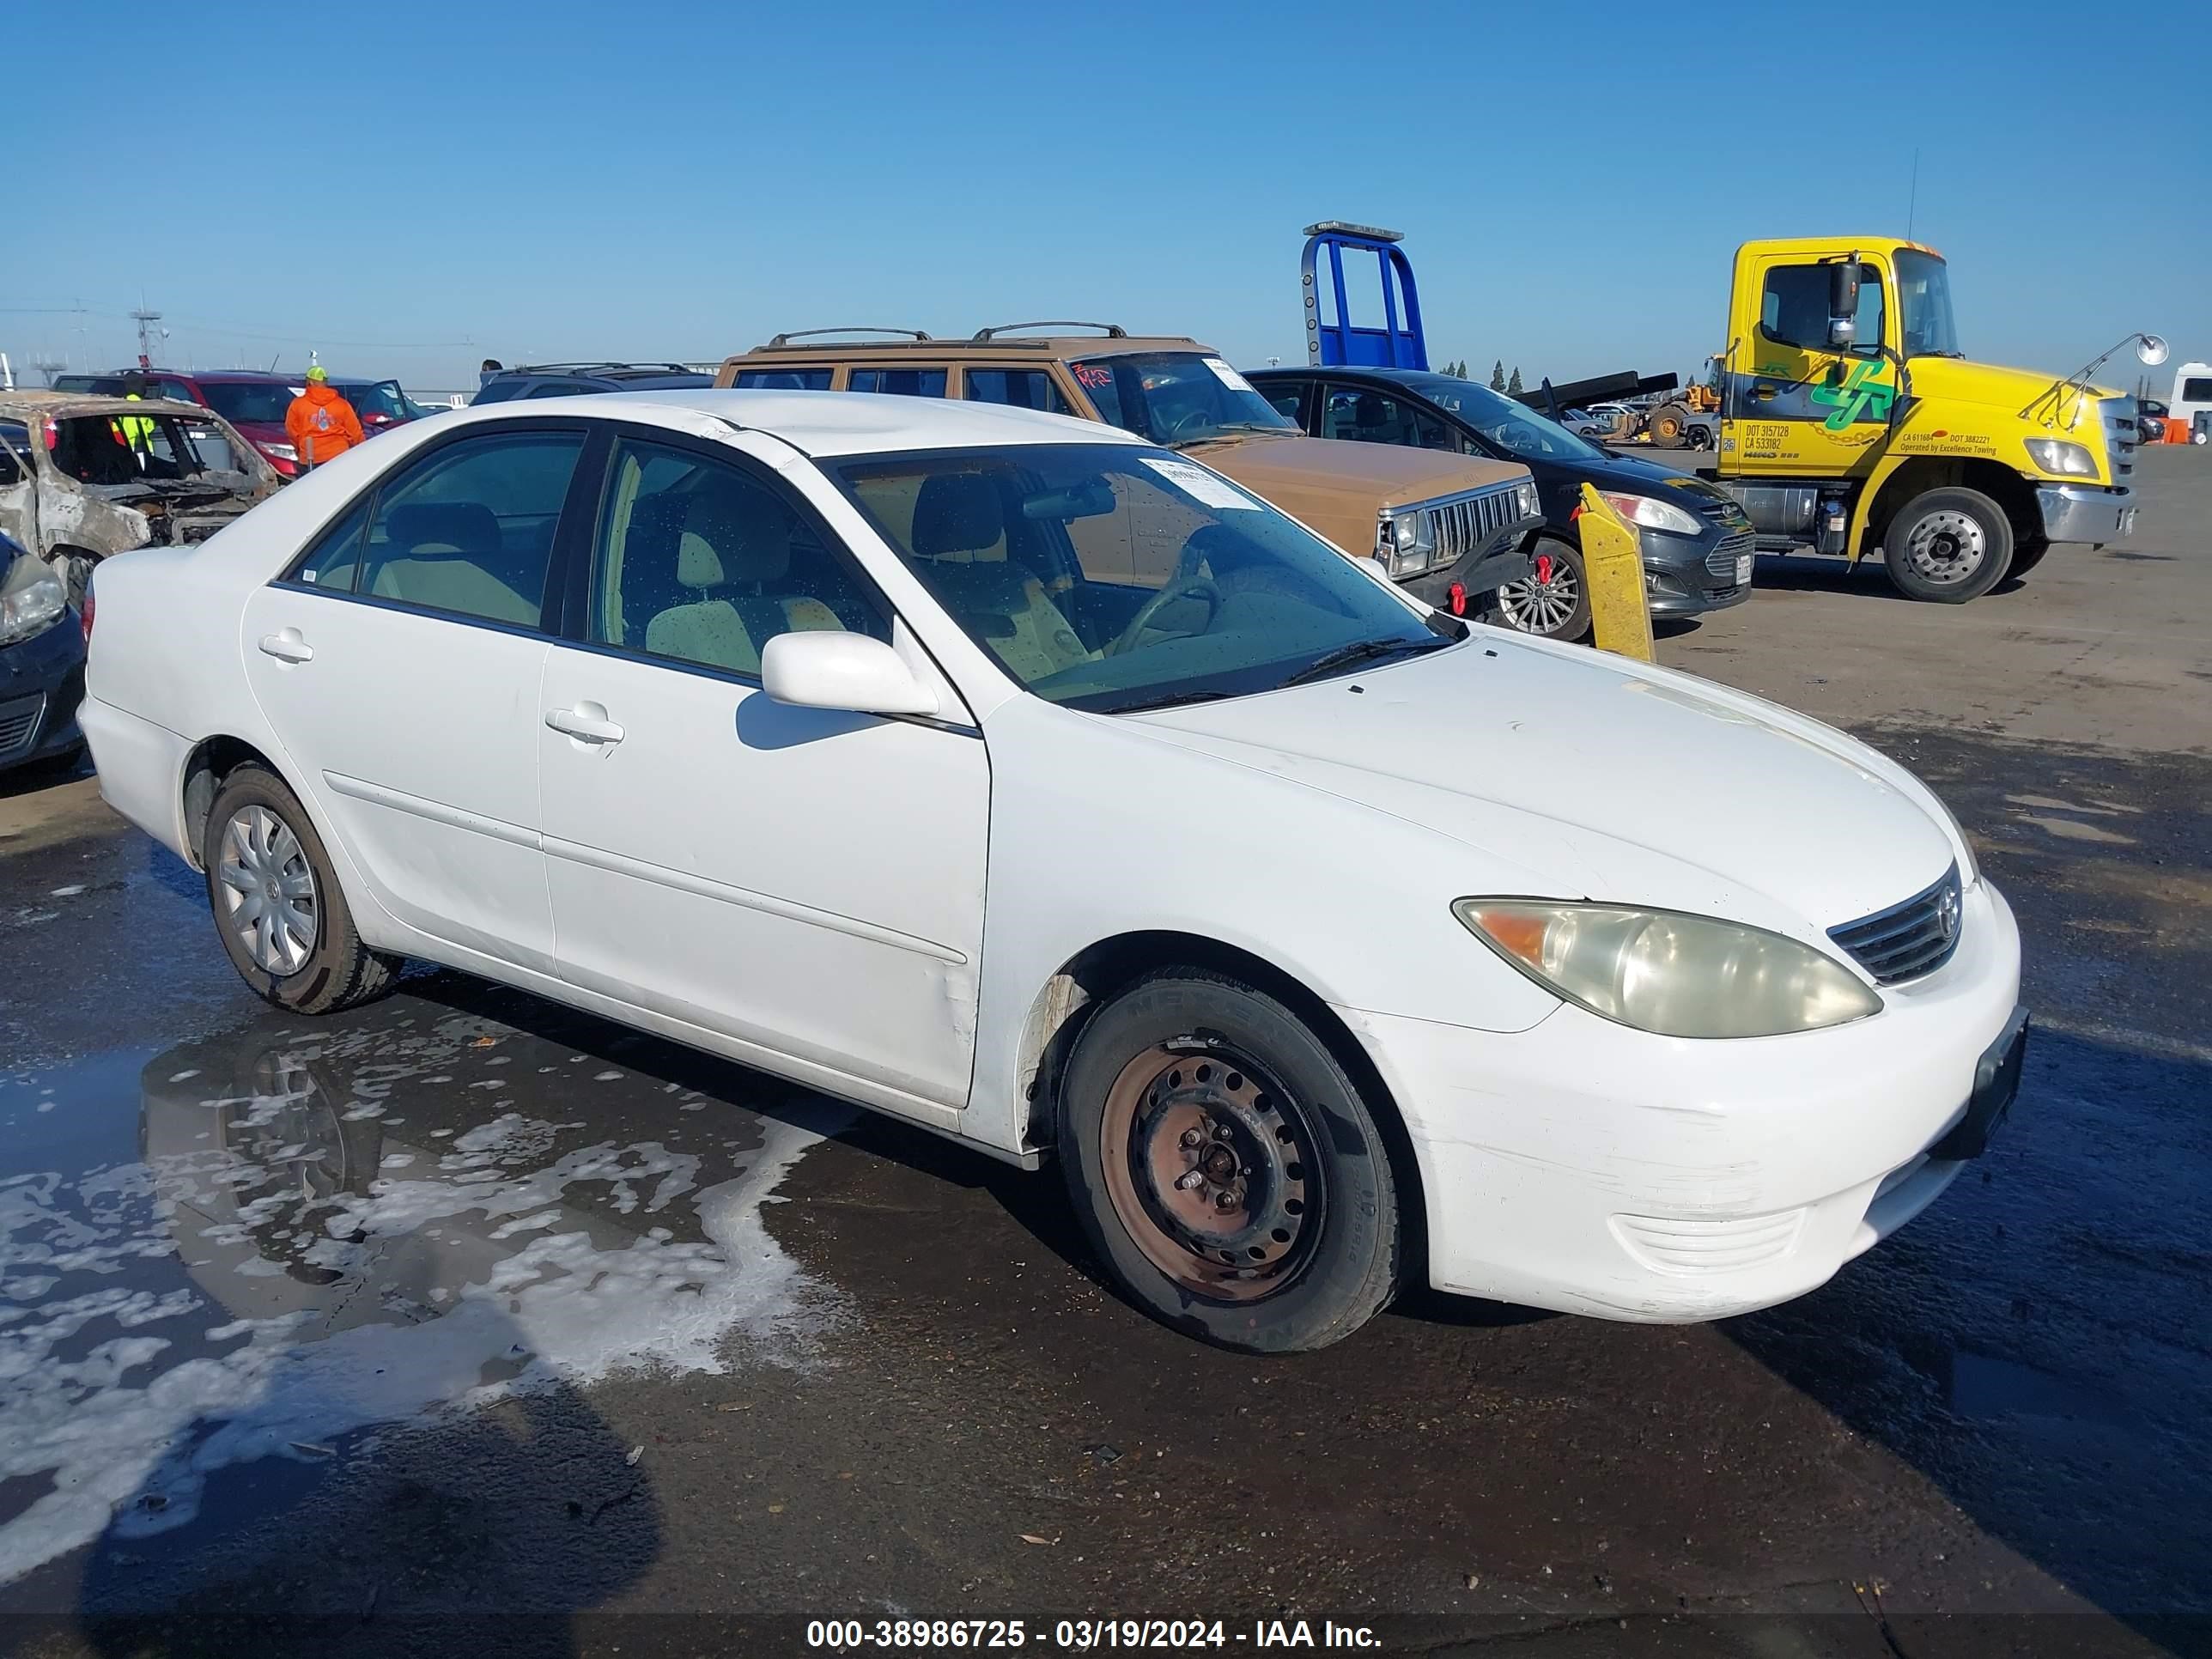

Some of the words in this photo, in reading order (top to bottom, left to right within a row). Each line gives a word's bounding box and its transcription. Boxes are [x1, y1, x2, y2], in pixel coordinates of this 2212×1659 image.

[1746, 424, 1760, 437] DOT
[1761, 425, 1790, 437] 3157128
[1745, 437, 1754, 449] CA
[1755, 438, 1781, 450] 533182
[1902, 433, 1911, 441] CA
[1965, 435, 1990, 444] 3882221
[1724, 441, 1734, 451] 26
[1930, 444, 1940, 453] by
[1974, 446, 1997, 456] Towing
